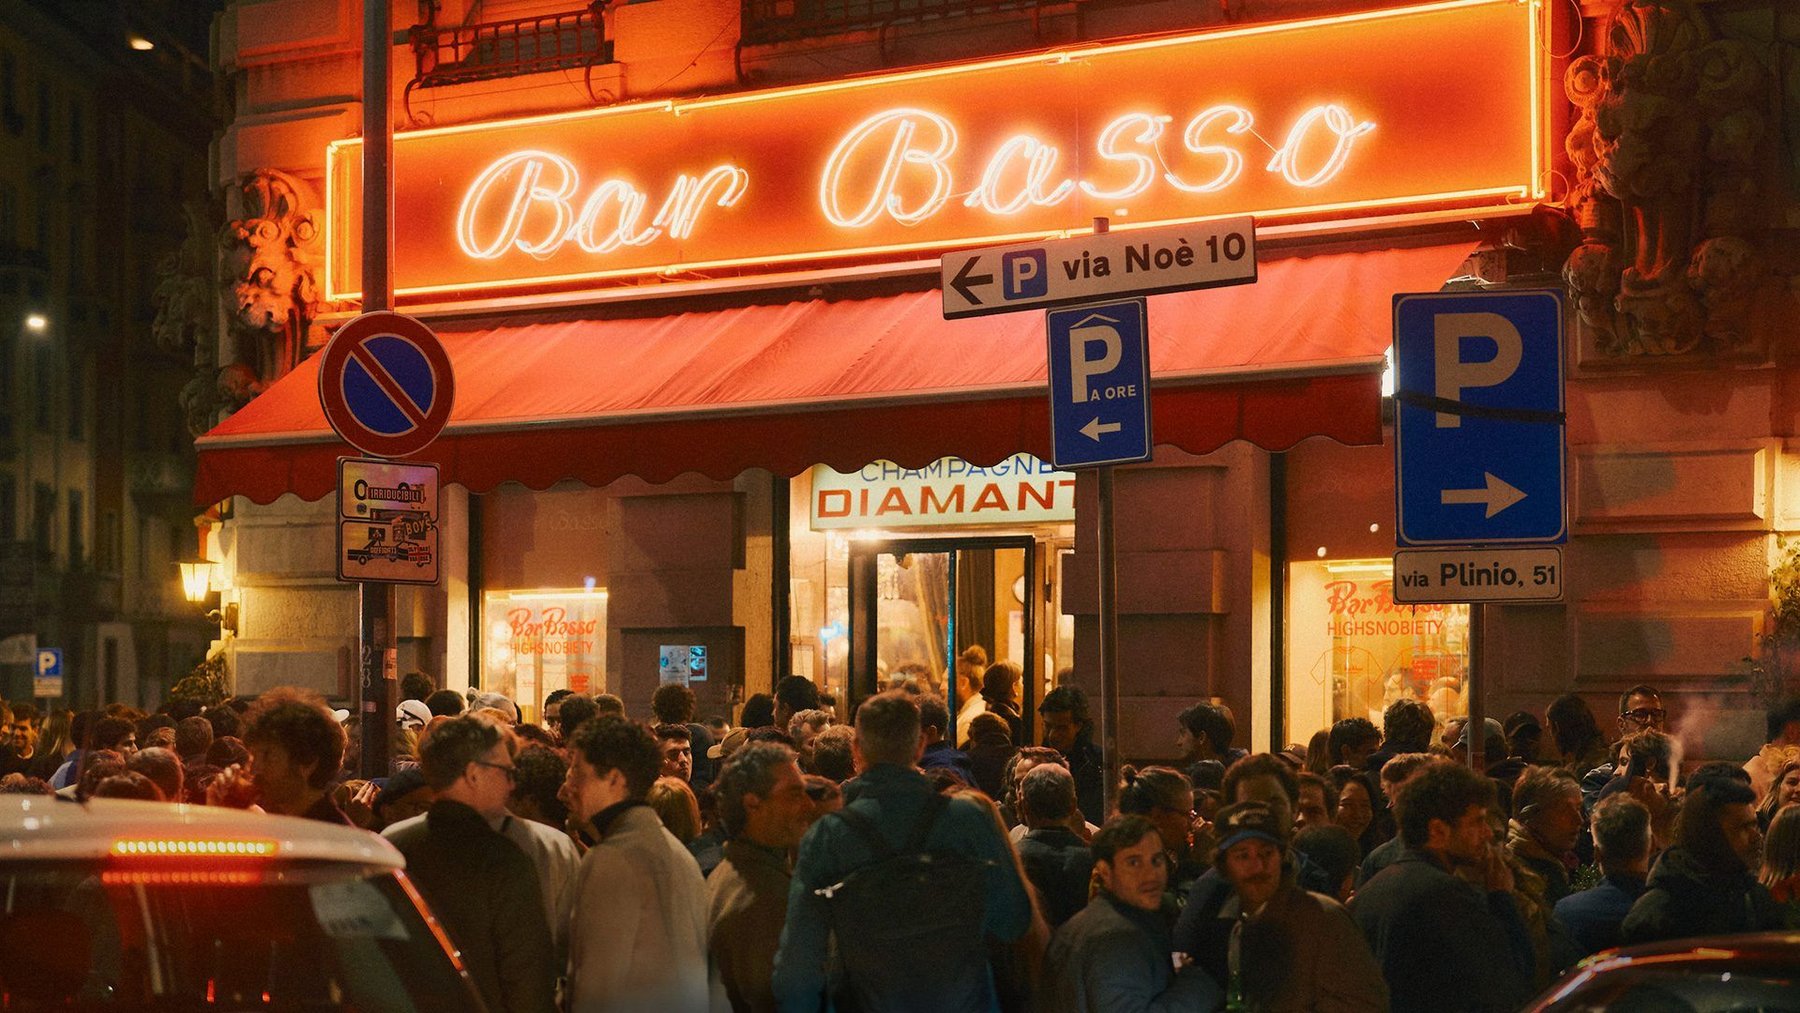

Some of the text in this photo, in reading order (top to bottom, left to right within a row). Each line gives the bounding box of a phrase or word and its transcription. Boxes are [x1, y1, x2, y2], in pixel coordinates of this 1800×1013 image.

[457, 105, 1376, 260] Bar Basso
[1012, 232, 1246, 293] P via Noè 10
[1069, 324, 1122, 403] P
[1434, 312, 1523, 428] P
[1091, 385, 1136, 401] A ORE
[405, 518, 432, 536] BOYS
[1402, 562, 1556, 590] via Plinio, 51
[1324, 581, 1374, 618] Bar
[507, 607, 597, 640] Bar Basso
[1327, 620, 1443, 636] HIGHSNOBIETY
[39, 651, 56, 675] P
[510, 641, 594, 655] HIGHSNOBIETY
